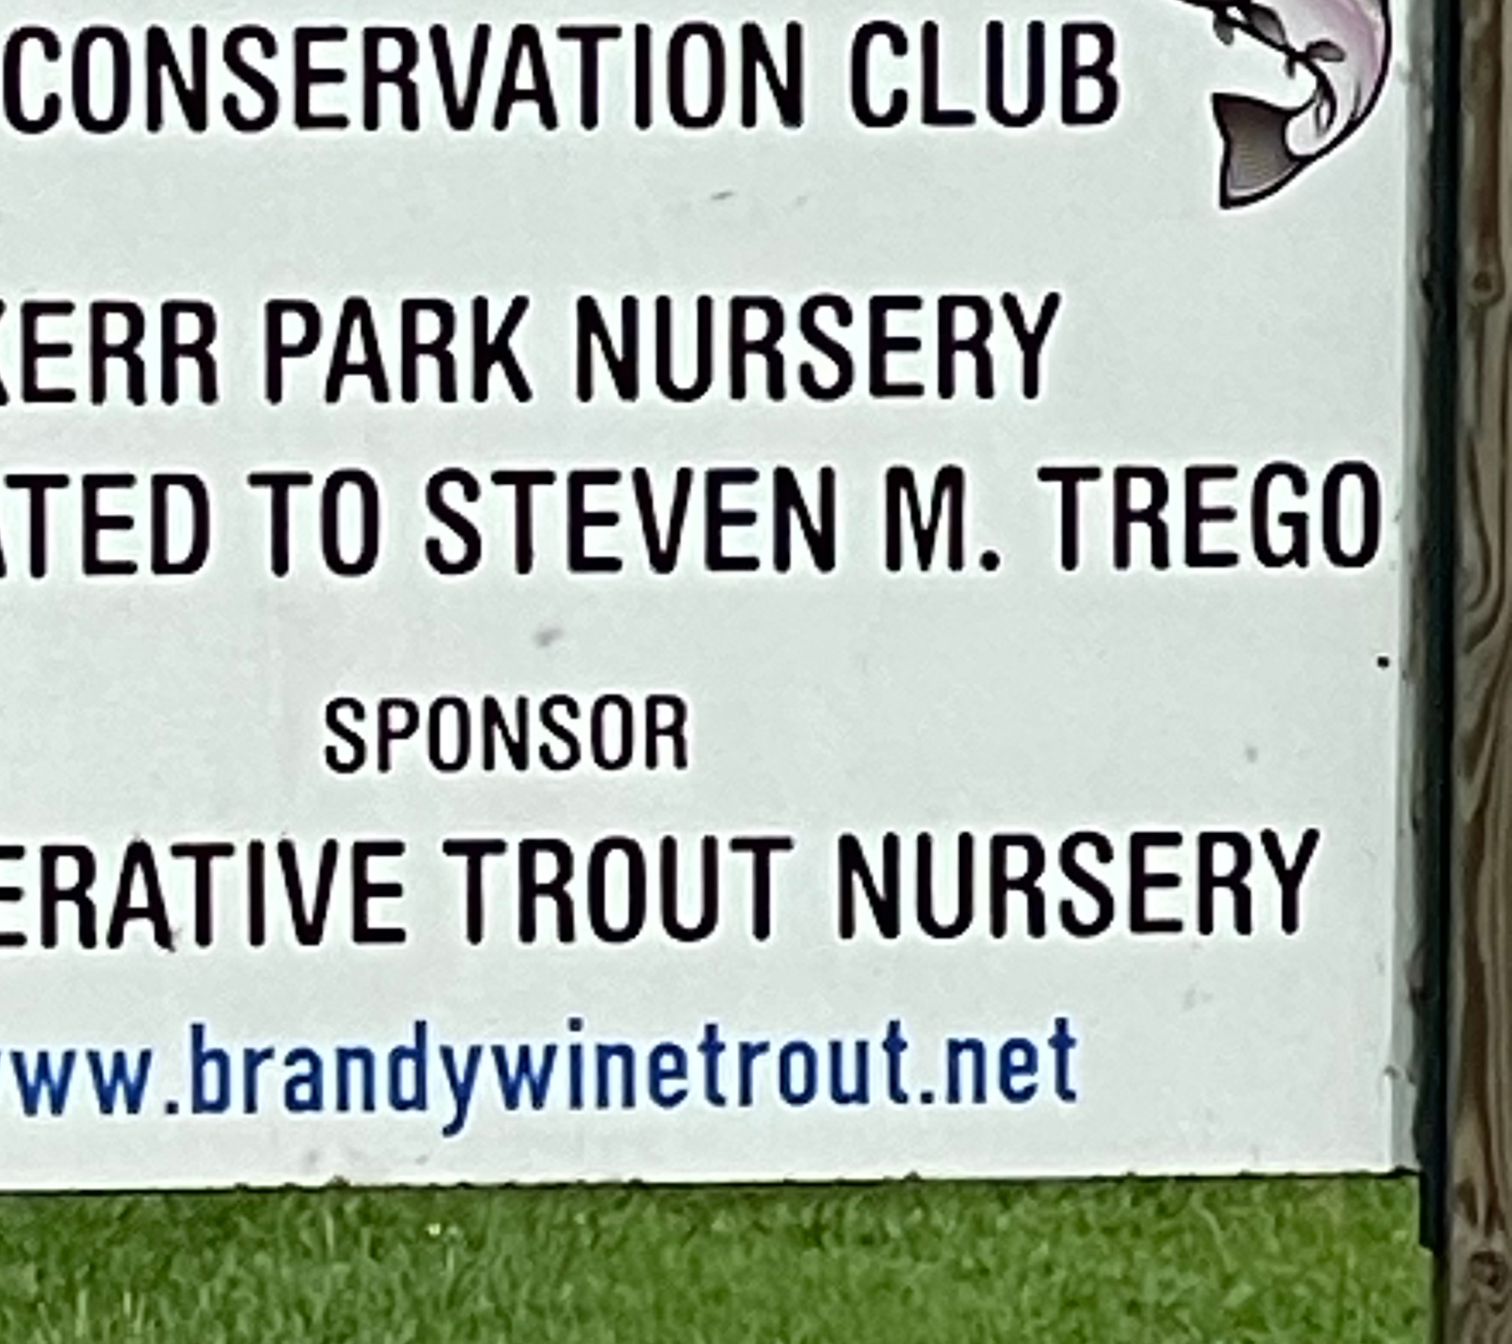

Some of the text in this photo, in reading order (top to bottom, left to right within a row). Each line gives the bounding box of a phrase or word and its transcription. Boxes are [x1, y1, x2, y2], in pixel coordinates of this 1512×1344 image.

[4, 22, 802, 134] CONSERVATION
[852, 21, 1117, 127] CLUB
[266, 296, 532, 404] PARK
[577, 293, 1059, 402] NURSERY
[248, 470, 379, 577] TO
[426, 467, 835, 574] STEVEN
[886, 465, 999, 571] M.
[1038, 462, 1380, 571] TREGO
[326, 695, 688, 774] SPONSOR
[443, 836, 793, 944] TROUT
[839, 829, 1319, 939] NURSERY
